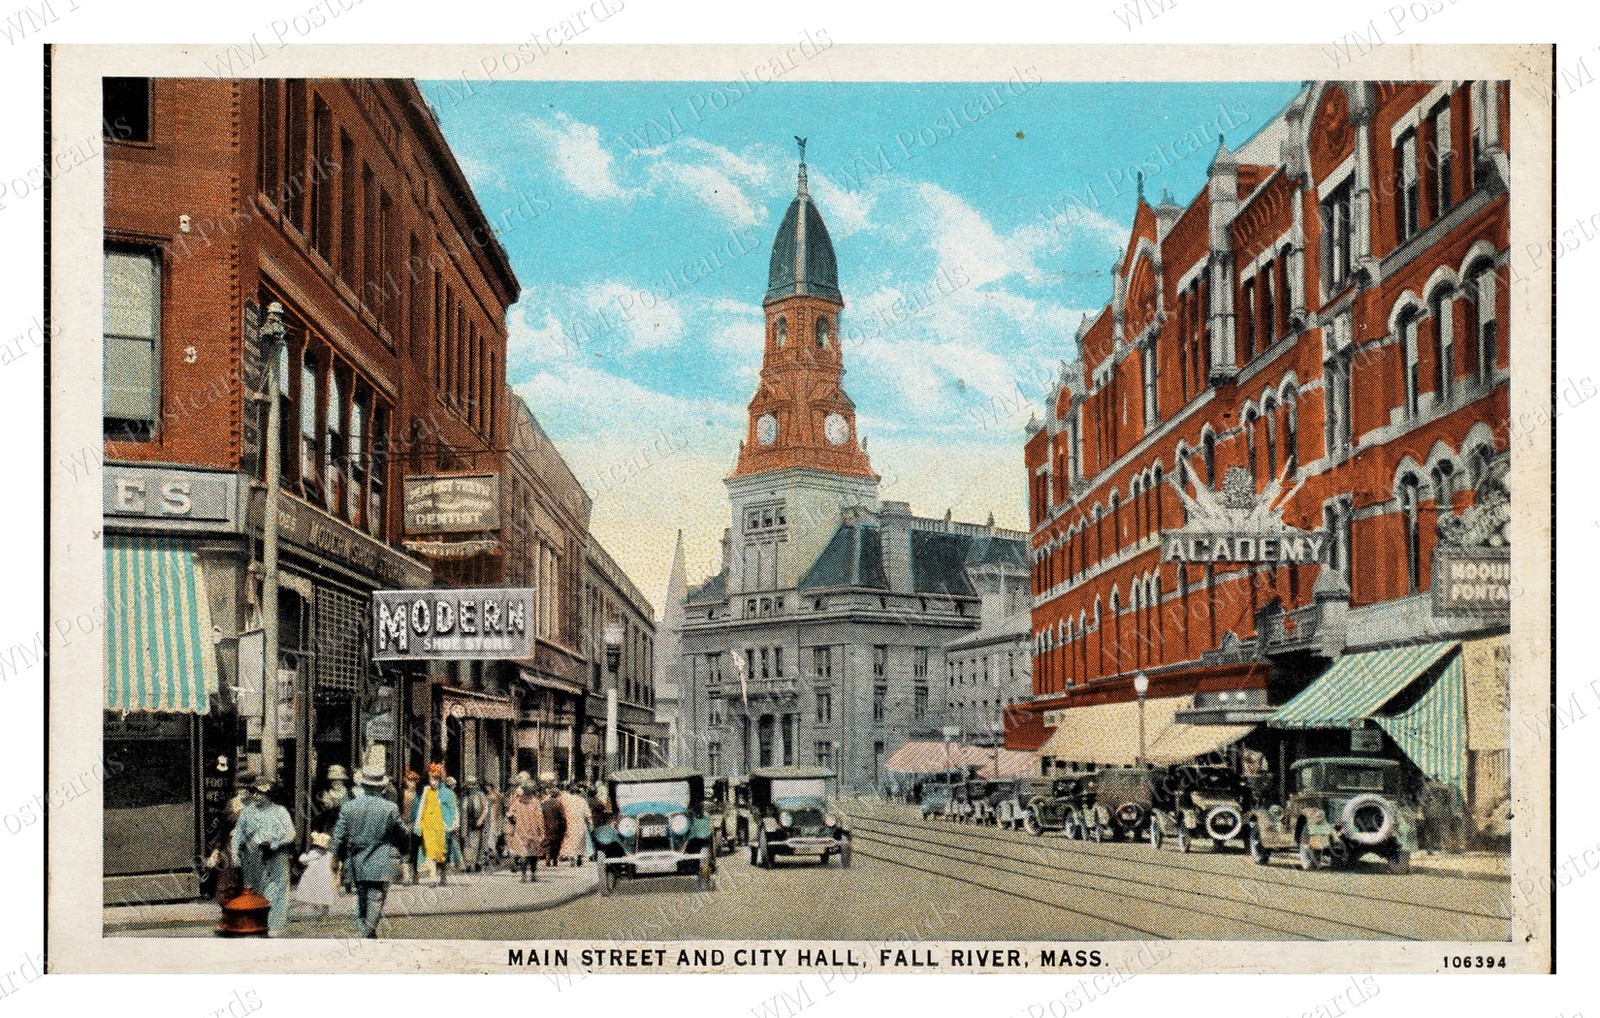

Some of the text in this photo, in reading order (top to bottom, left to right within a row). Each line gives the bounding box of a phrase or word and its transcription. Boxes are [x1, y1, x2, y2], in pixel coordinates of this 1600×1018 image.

[415, 512, 483, 525] DENTIST
[1165, 536, 1325, 562] ACADEMY
[378, 597, 526, 651] MODERN
[423, 637, 514, 651] SHOE STORE
